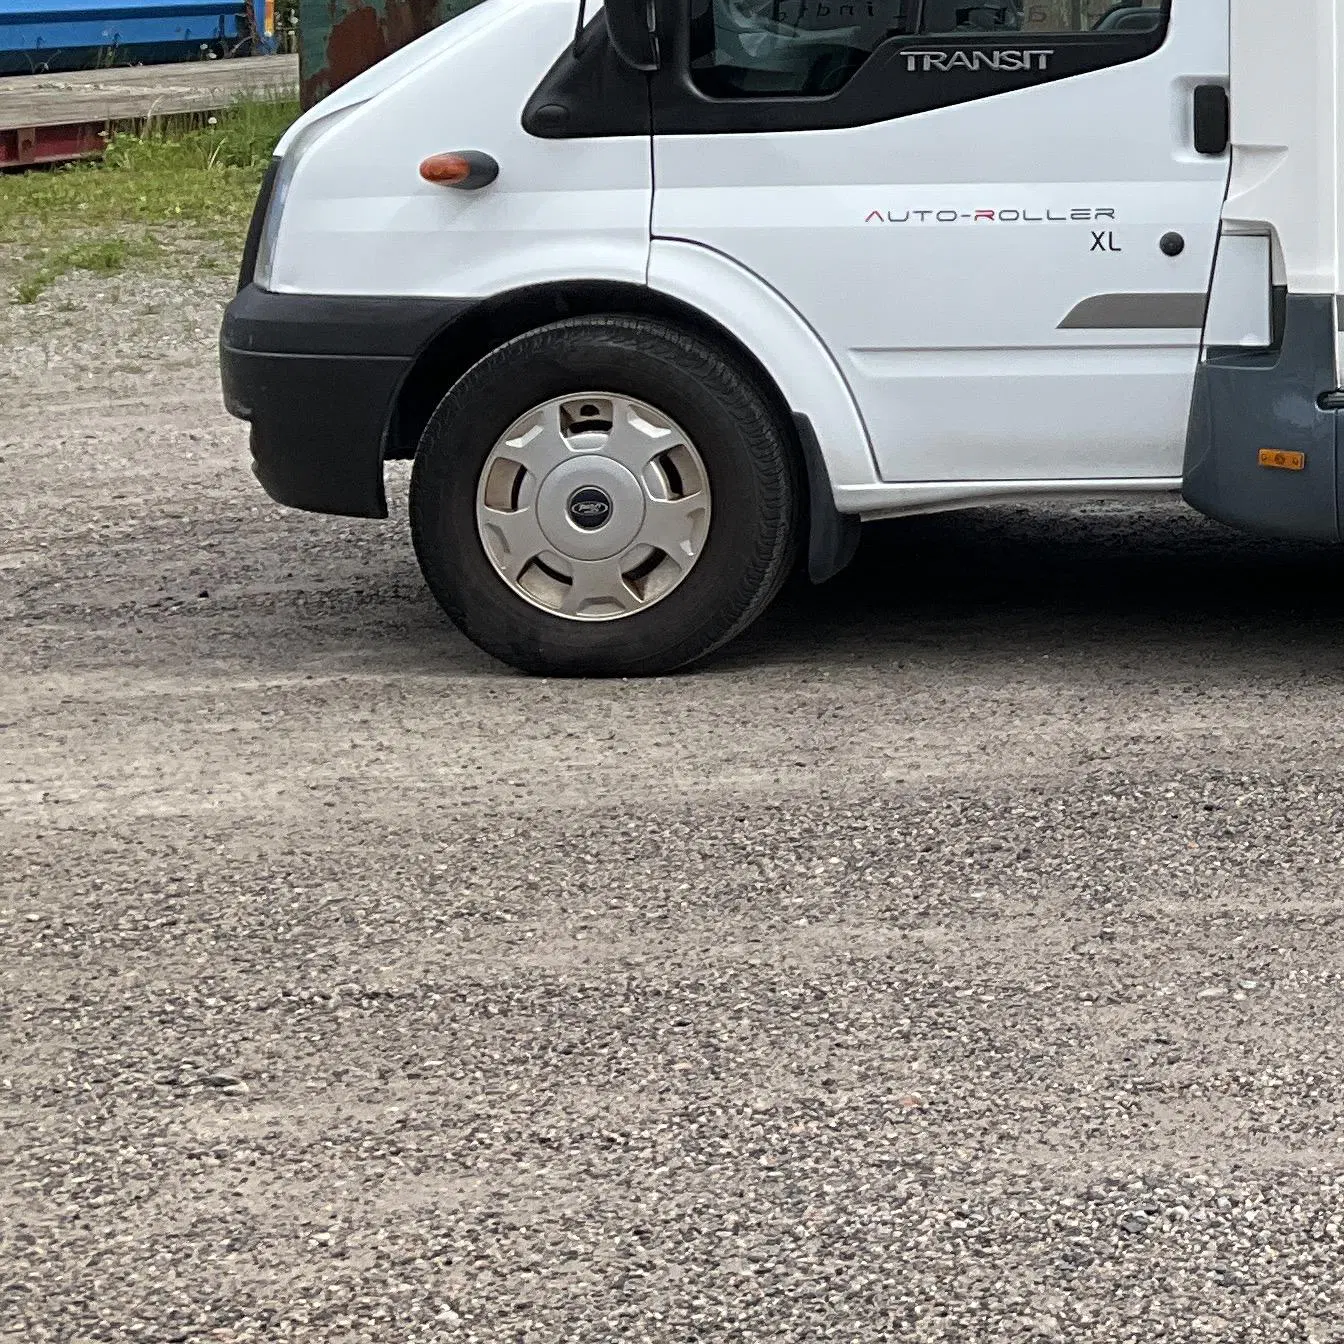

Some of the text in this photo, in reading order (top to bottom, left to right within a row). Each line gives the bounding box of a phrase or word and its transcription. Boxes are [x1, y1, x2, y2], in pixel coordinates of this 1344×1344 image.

[900, 50, 1054, 72] TRANSIT
[865, 208, 1116, 223] AUTO-ROLLER
[1090, 231, 1122, 252] XL
